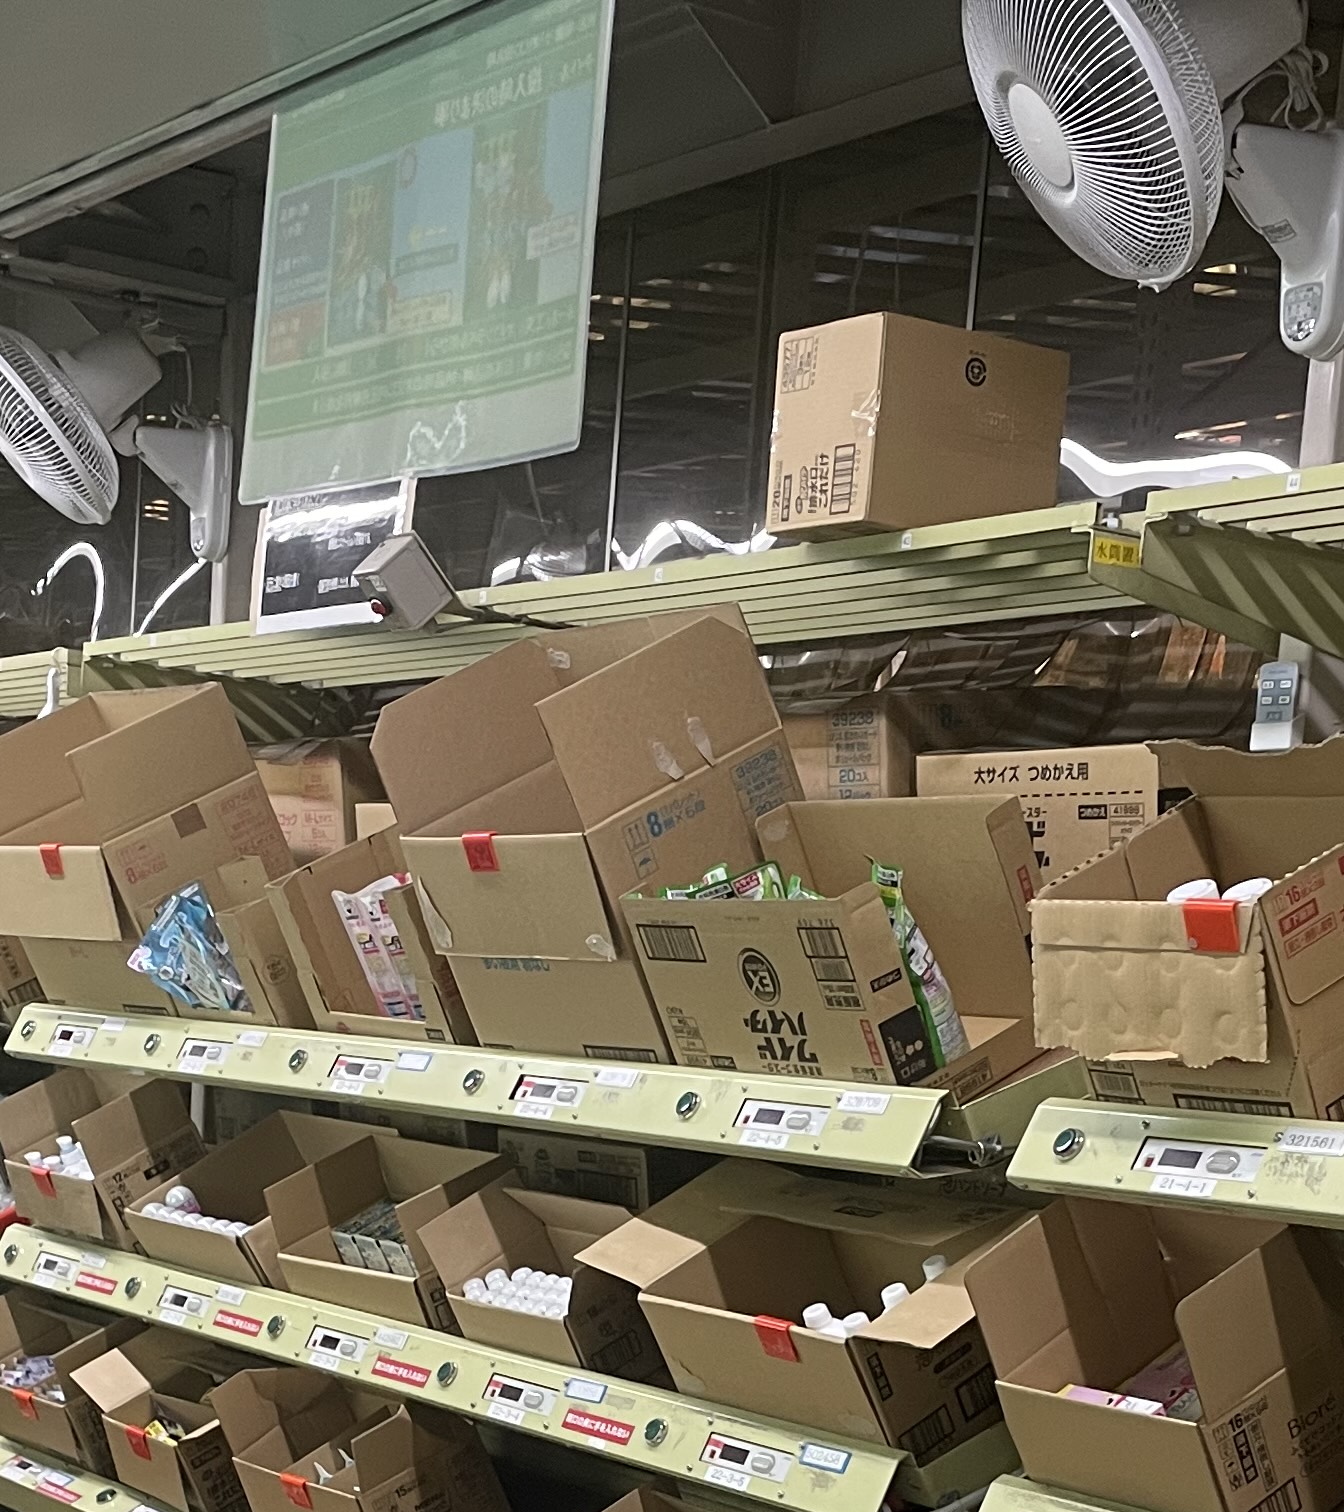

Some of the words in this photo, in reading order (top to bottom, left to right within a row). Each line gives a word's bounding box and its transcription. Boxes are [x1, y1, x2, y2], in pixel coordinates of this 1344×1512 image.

[819, 452, 829, 508] これだけ
[974, 765, 1020, 784] 大サイズ
[1027, 762, 1089, 782] つめかえ用
[1285, 885, 1301, 906] 16
[743, 1009, 806, 1036] ハイター
[755, 1037, 819, 1063] ワイド
[1285, 1133, 1337, 1150] 321561
[1227, 1412, 1244, 1433] 16
